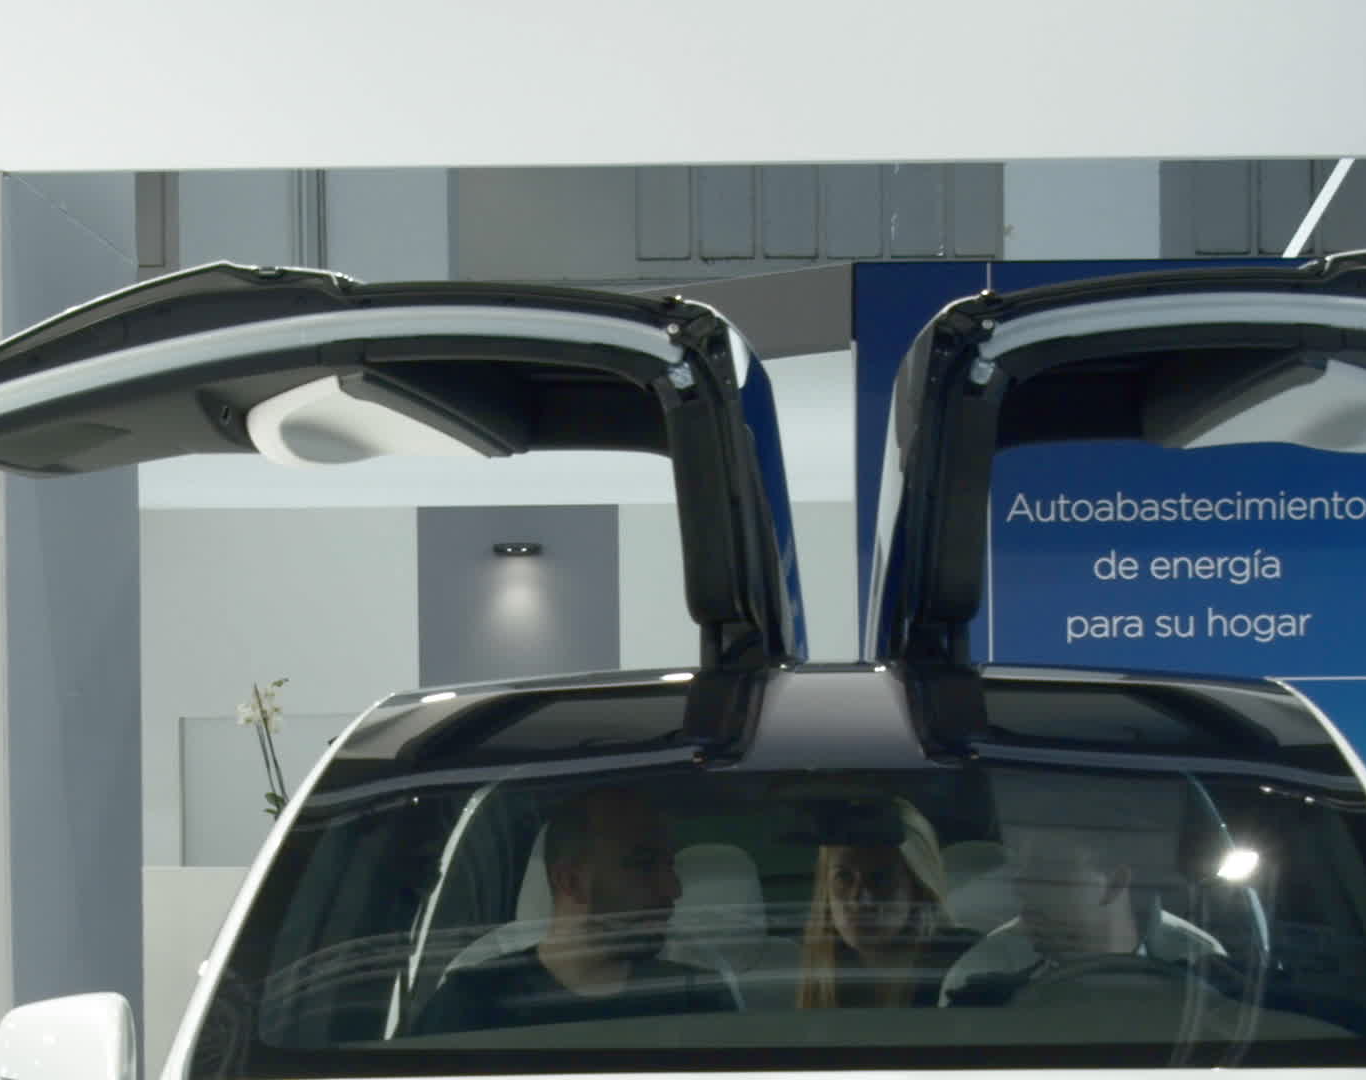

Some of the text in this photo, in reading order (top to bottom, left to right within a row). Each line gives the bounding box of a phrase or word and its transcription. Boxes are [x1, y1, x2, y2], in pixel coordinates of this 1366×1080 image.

[1093, 548, 1282, 585] de energía
[1066, 607, 1313, 644] para su hogar
